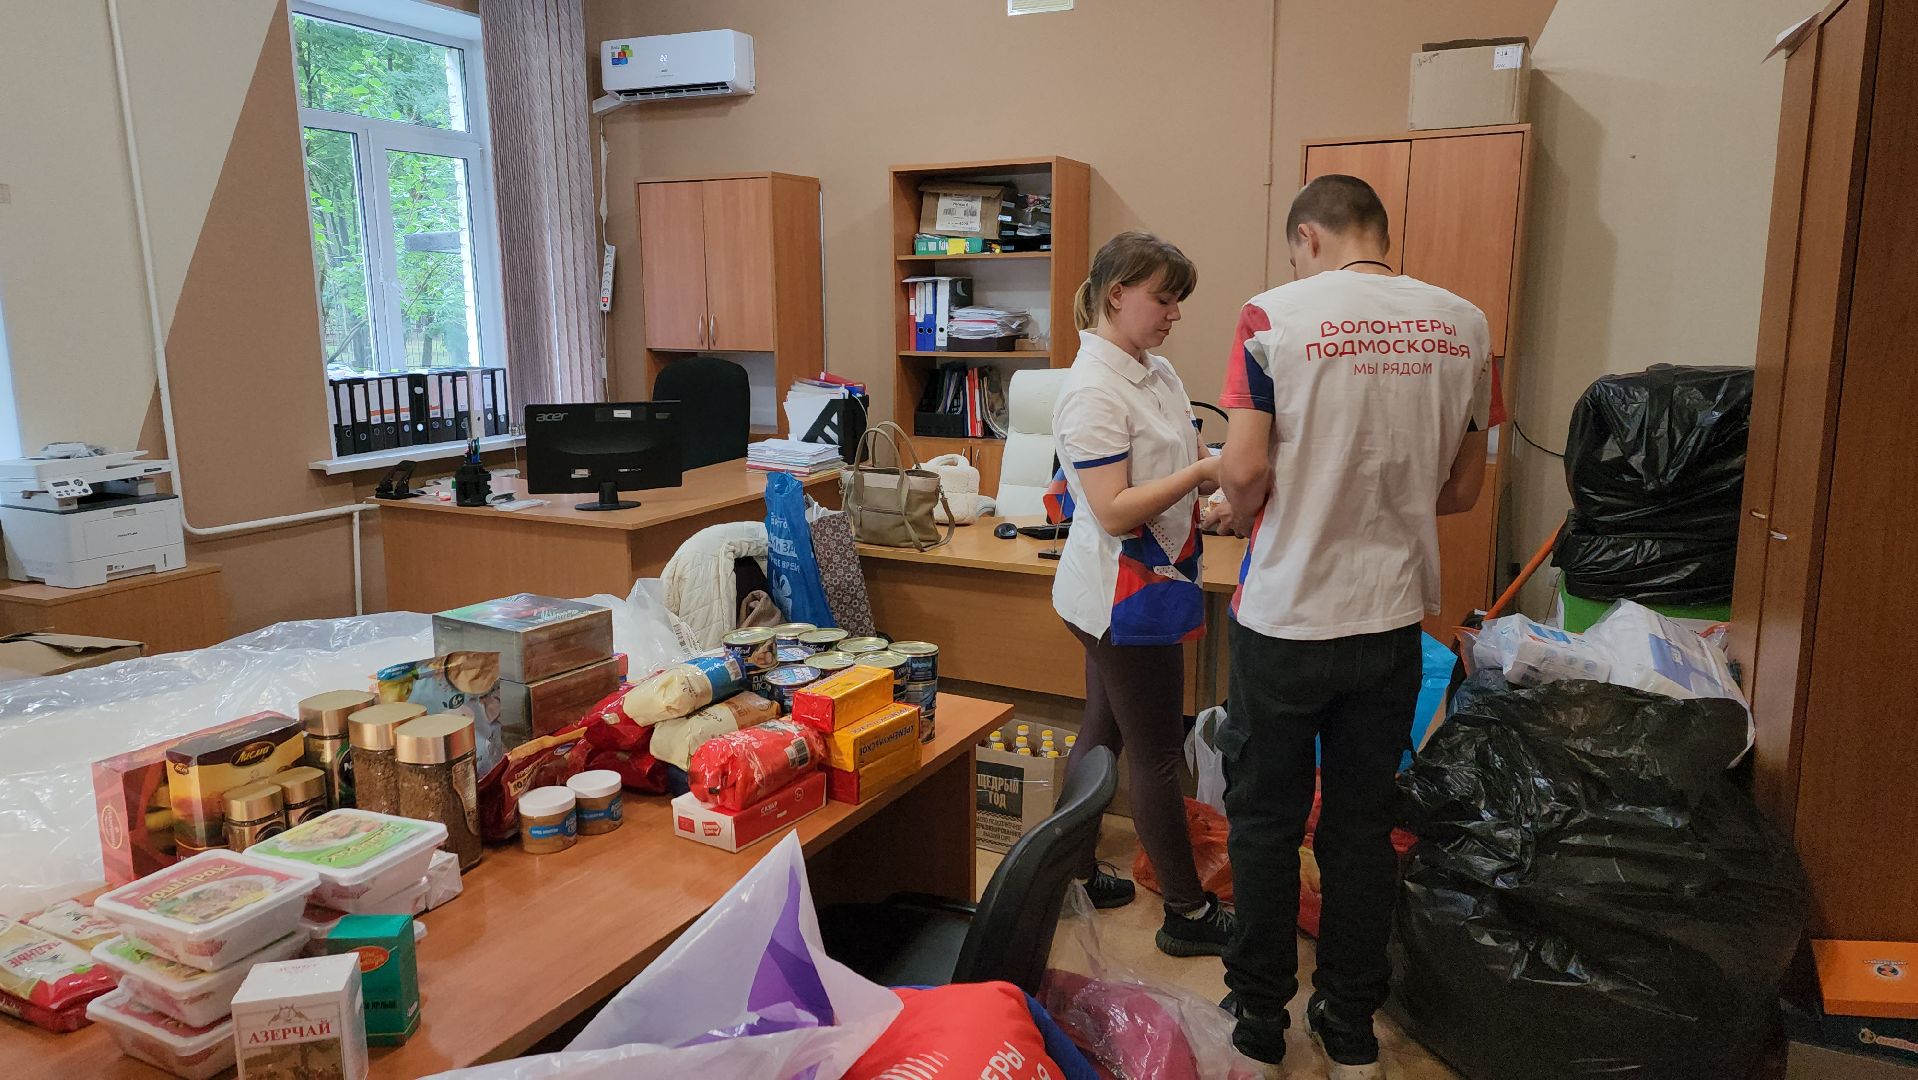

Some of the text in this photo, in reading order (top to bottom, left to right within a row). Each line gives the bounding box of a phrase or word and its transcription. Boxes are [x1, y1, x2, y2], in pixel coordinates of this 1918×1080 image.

[1320, 319, 1457, 338] ВОЛОНТЕРЫ
[1305, 338, 1471, 361] ПОДМОСКОВЬЯ
[1353, 362, 1433, 377] МЫ РЯДОМ
[535, 412, 568, 422] acer
[249, 1019, 332, 1044] АЗЕРЧАЙ
